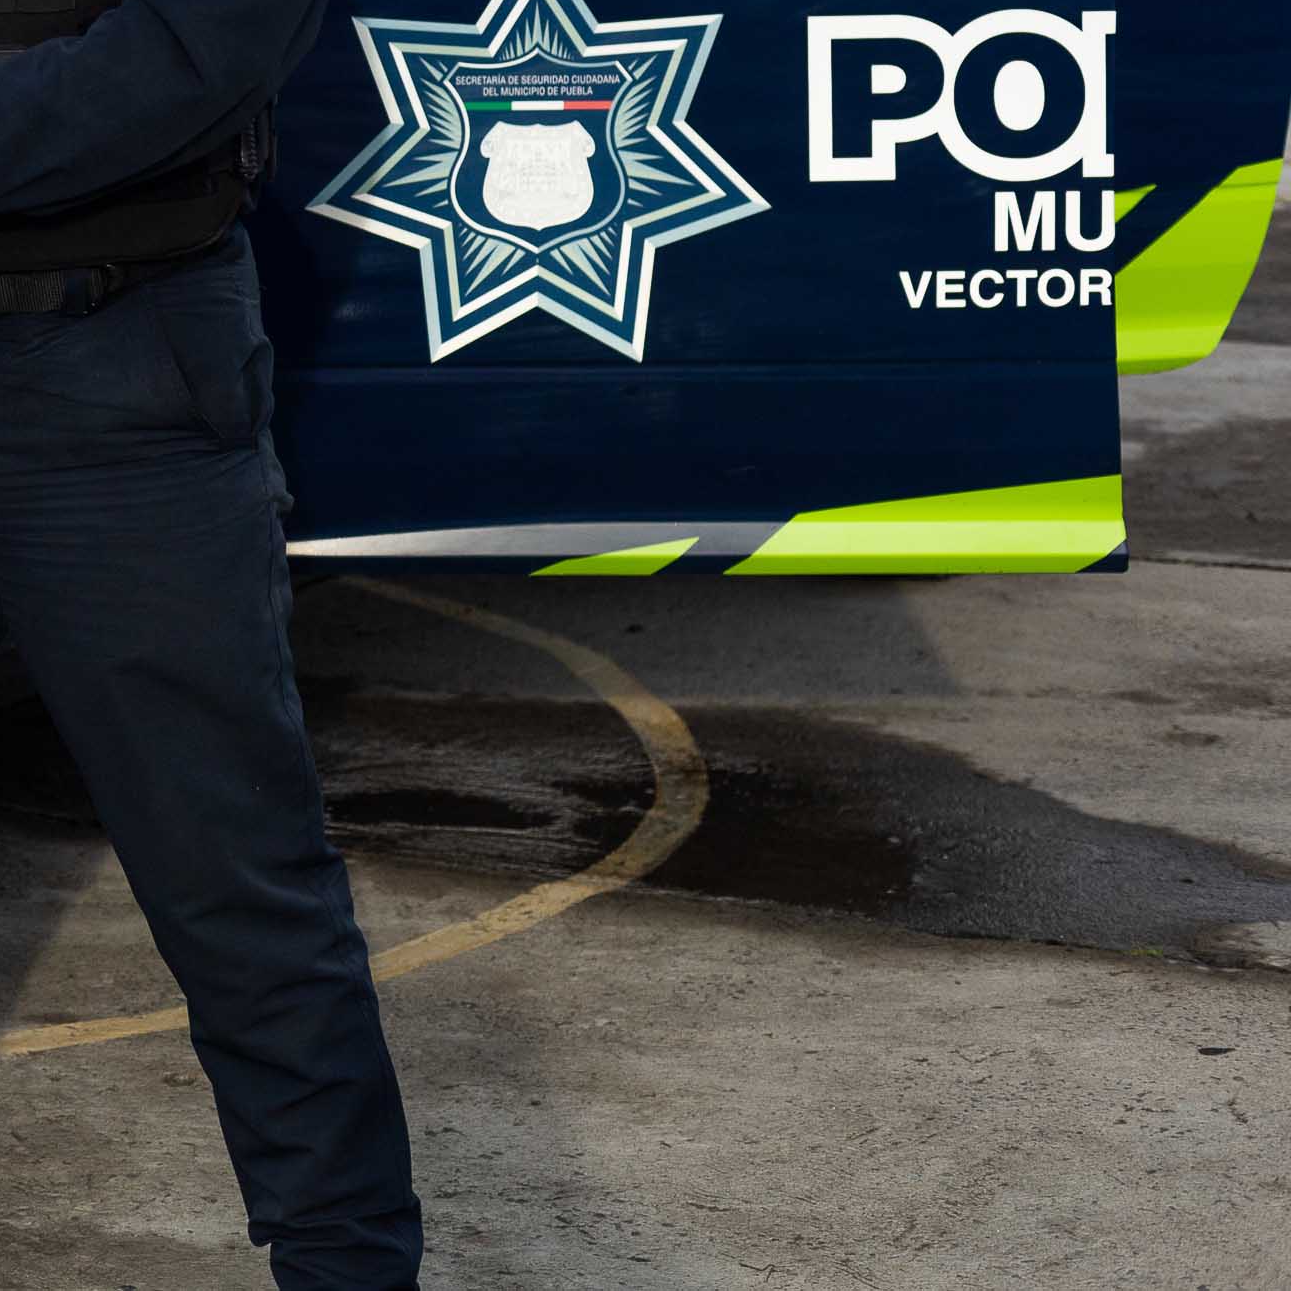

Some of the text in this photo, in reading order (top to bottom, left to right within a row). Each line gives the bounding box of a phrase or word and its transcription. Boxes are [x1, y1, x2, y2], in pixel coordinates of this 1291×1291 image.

[456, 74, 620, 86] SECRETARÍA DE SEGURIDAD CIUDADANA
[482, 85, 593, 96] DEL MUNICIPIO DE PUEBLA
[899, 267, 1113, 309] VECTOR
